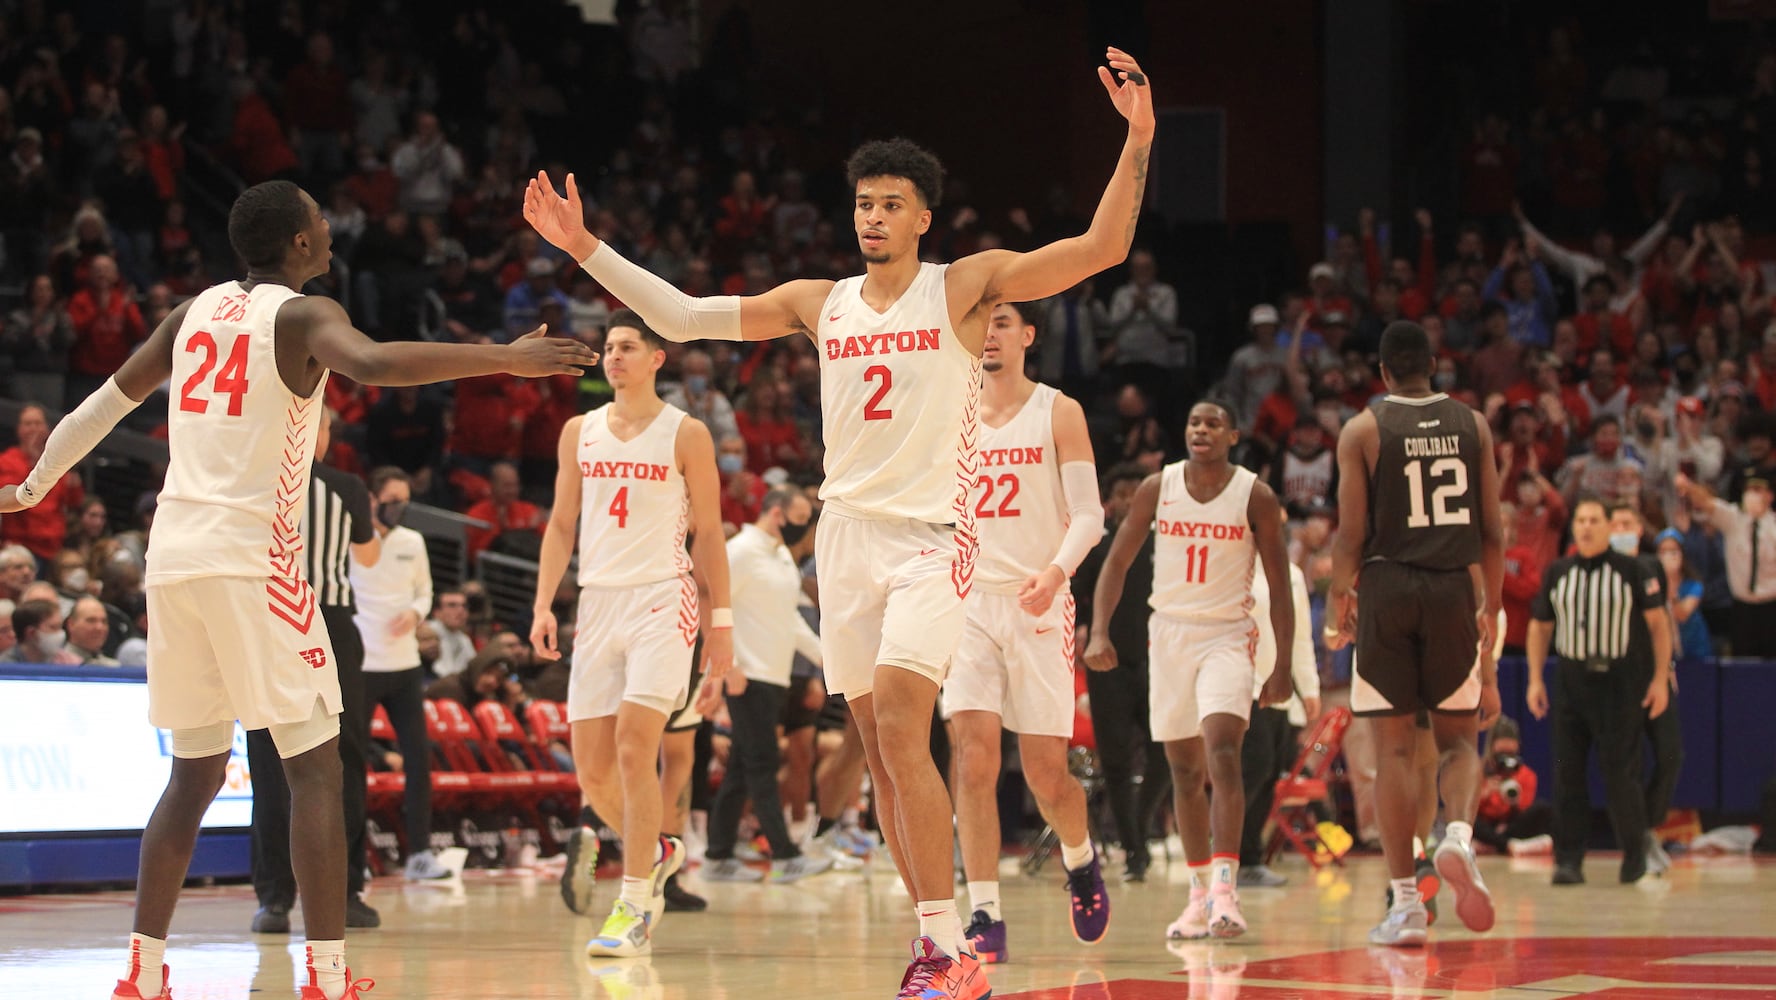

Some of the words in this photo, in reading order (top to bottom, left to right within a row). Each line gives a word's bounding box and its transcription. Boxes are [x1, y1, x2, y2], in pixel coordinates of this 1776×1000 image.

[826, 328, 941, 360] DAYTON
[180, 330, 250, 416] 24
[863, 365, 892, 421] 2
[979, 446, 1044, 468] YTON
[1404, 435, 1460, 457] COULIBALY
[581, 460, 670, 482] DAYTON
[608, 486, 629, 529] 4
[973, 473, 1021, 519] 22
[1403, 457, 1471, 529] 12
[1158, 519, 1246, 541] DAYTON
[1186, 544, 1209, 584] 11
